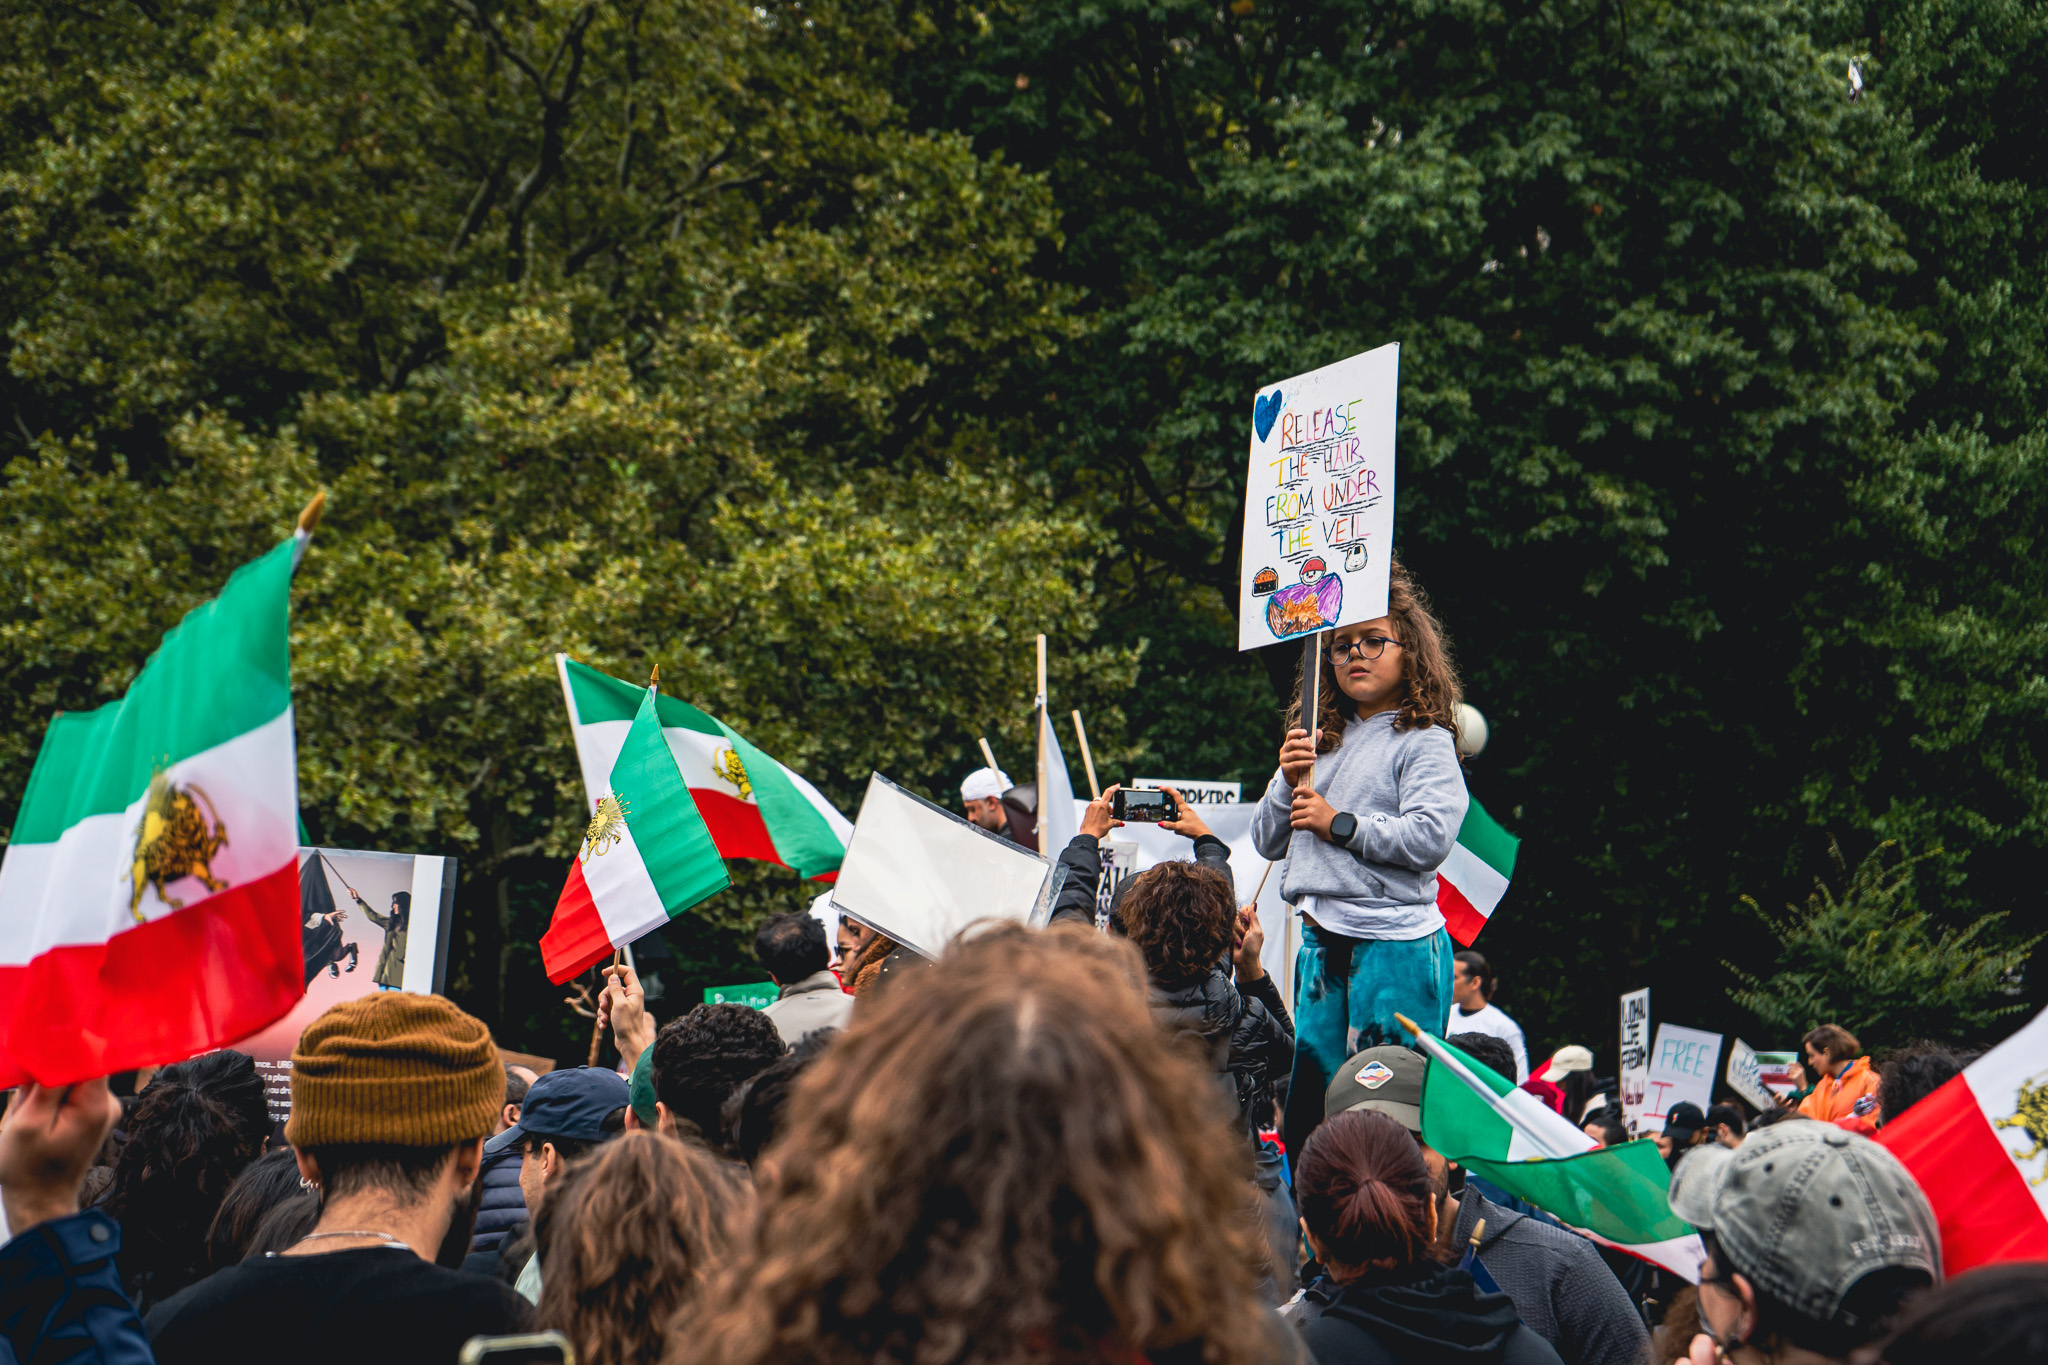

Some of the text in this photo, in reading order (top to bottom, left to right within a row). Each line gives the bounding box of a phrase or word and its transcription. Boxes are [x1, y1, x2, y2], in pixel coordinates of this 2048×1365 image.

[1281, 399, 1362, 450] RELEASE
[1269, 436, 1365, 487] THE HAIR
[1266, 468, 1380, 526] FROM UNDER
[1271, 514, 1371, 556] THE VEIL
[1660, 1039, 1711, 1078] FREE
